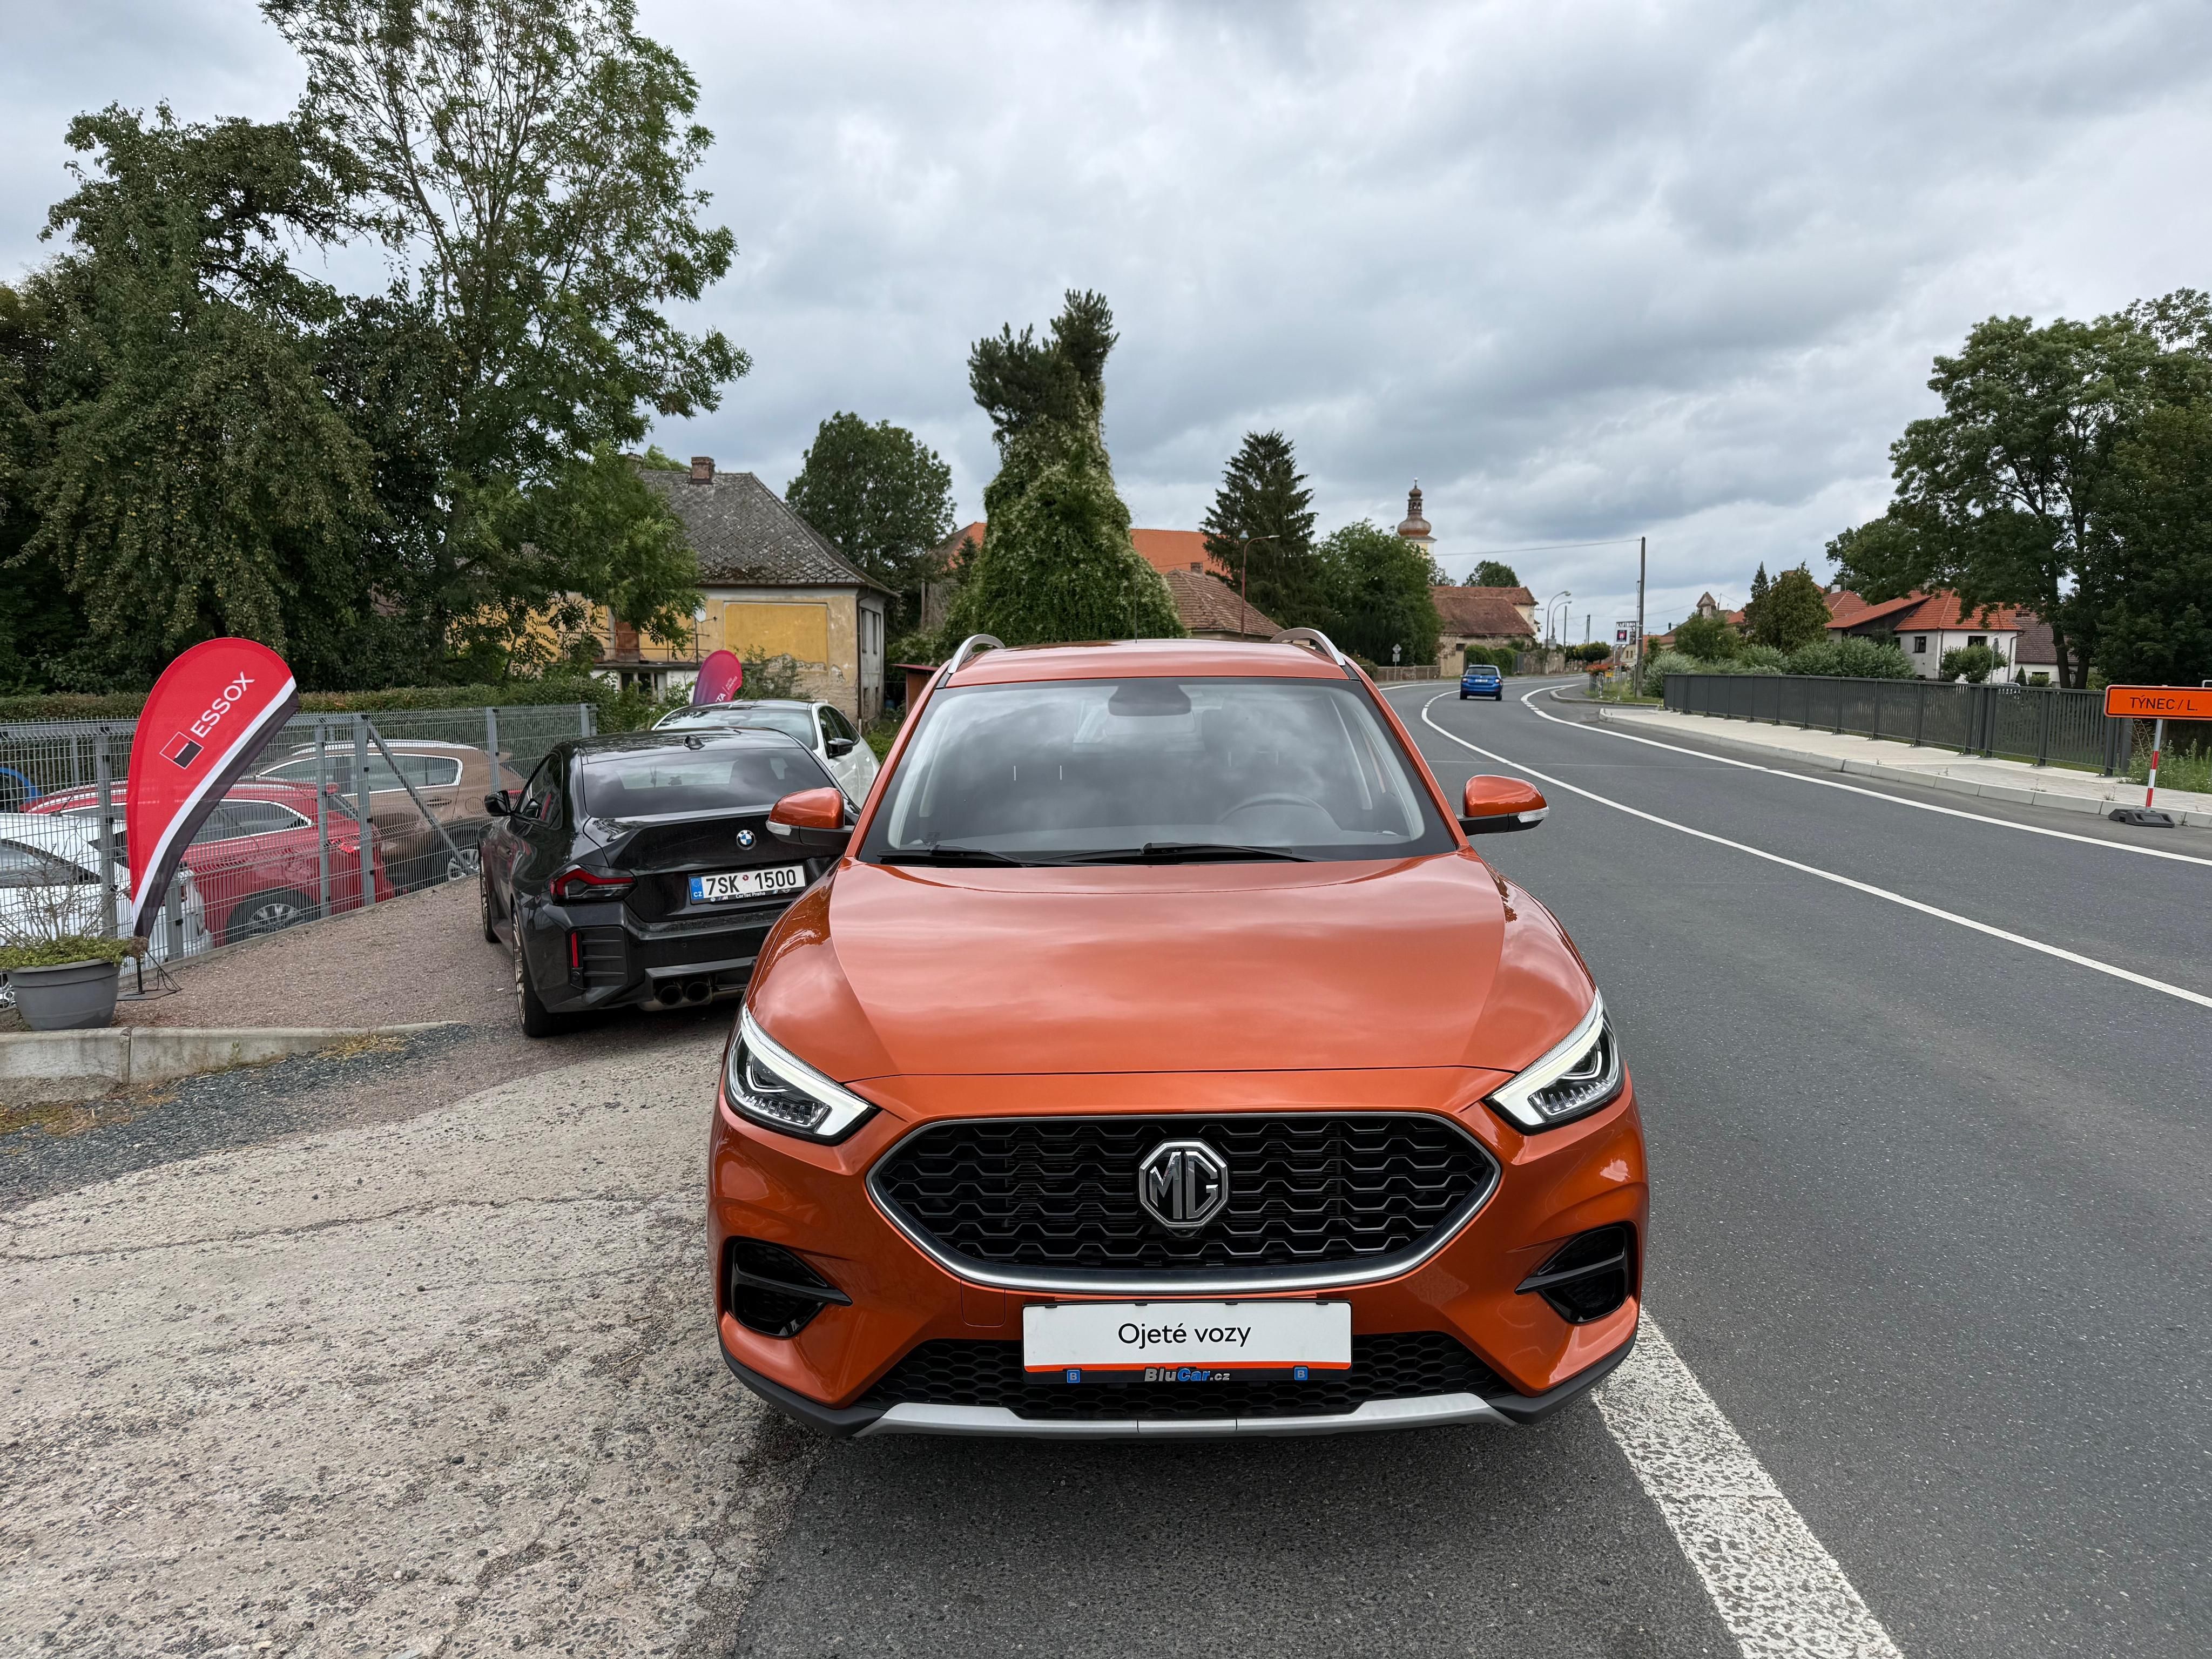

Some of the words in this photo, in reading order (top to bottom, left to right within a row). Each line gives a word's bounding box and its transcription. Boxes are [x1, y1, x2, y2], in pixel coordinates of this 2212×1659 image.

[190, 671, 255, 738] ESSOX
[2129, 694, 2175, 710] TÝNEC
[2187, 699, 2198, 711] L.
[706, 875, 740, 896] 7SK
[754, 868, 797, 890] 1500
[1149, 1151, 1219, 1219] MG
[1118, 1323, 1187, 1350] Ojeté
[1194, 1326, 1251, 1347] vozy
[1070, 1372, 1077, 1381] B
[1144, 1367, 1230, 1382] BluCar.cz
